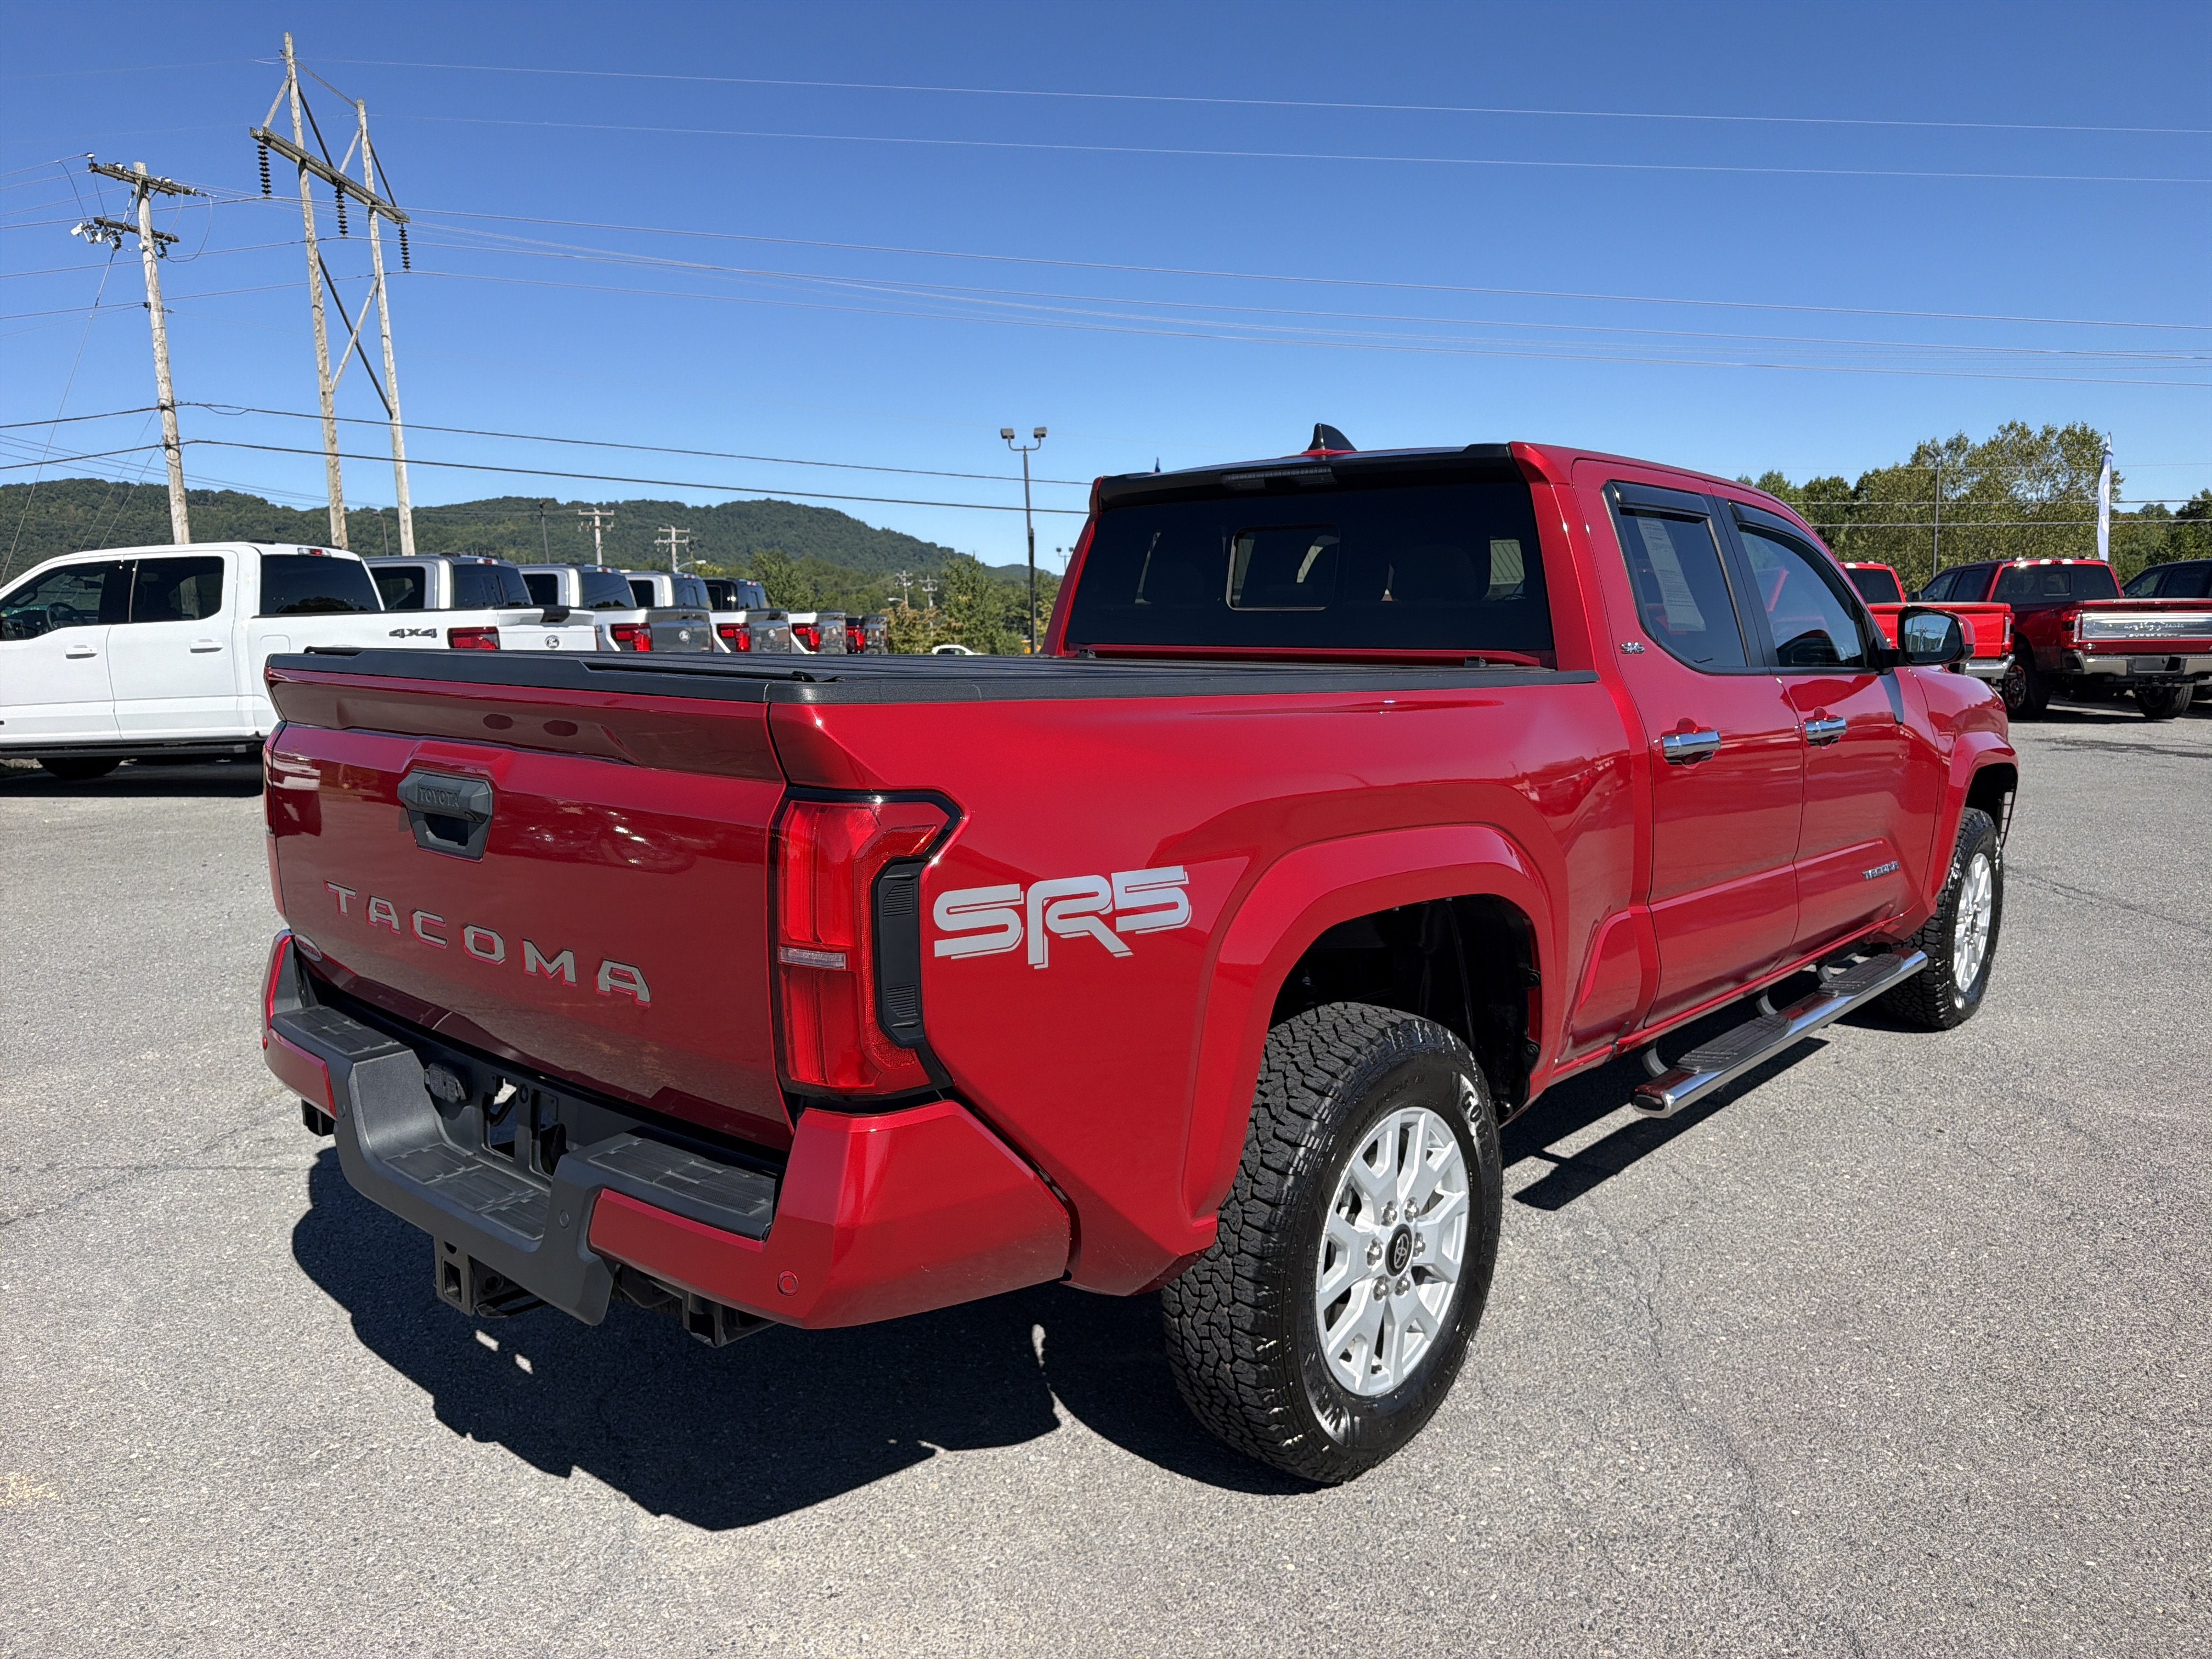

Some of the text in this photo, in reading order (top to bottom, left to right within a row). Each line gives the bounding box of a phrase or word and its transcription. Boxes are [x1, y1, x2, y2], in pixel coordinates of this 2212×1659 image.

[419, 787, 459, 808] TOYOTA
[324, 880, 651, 1007] TACOMA
[933, 865, 1192, 969] SR5
